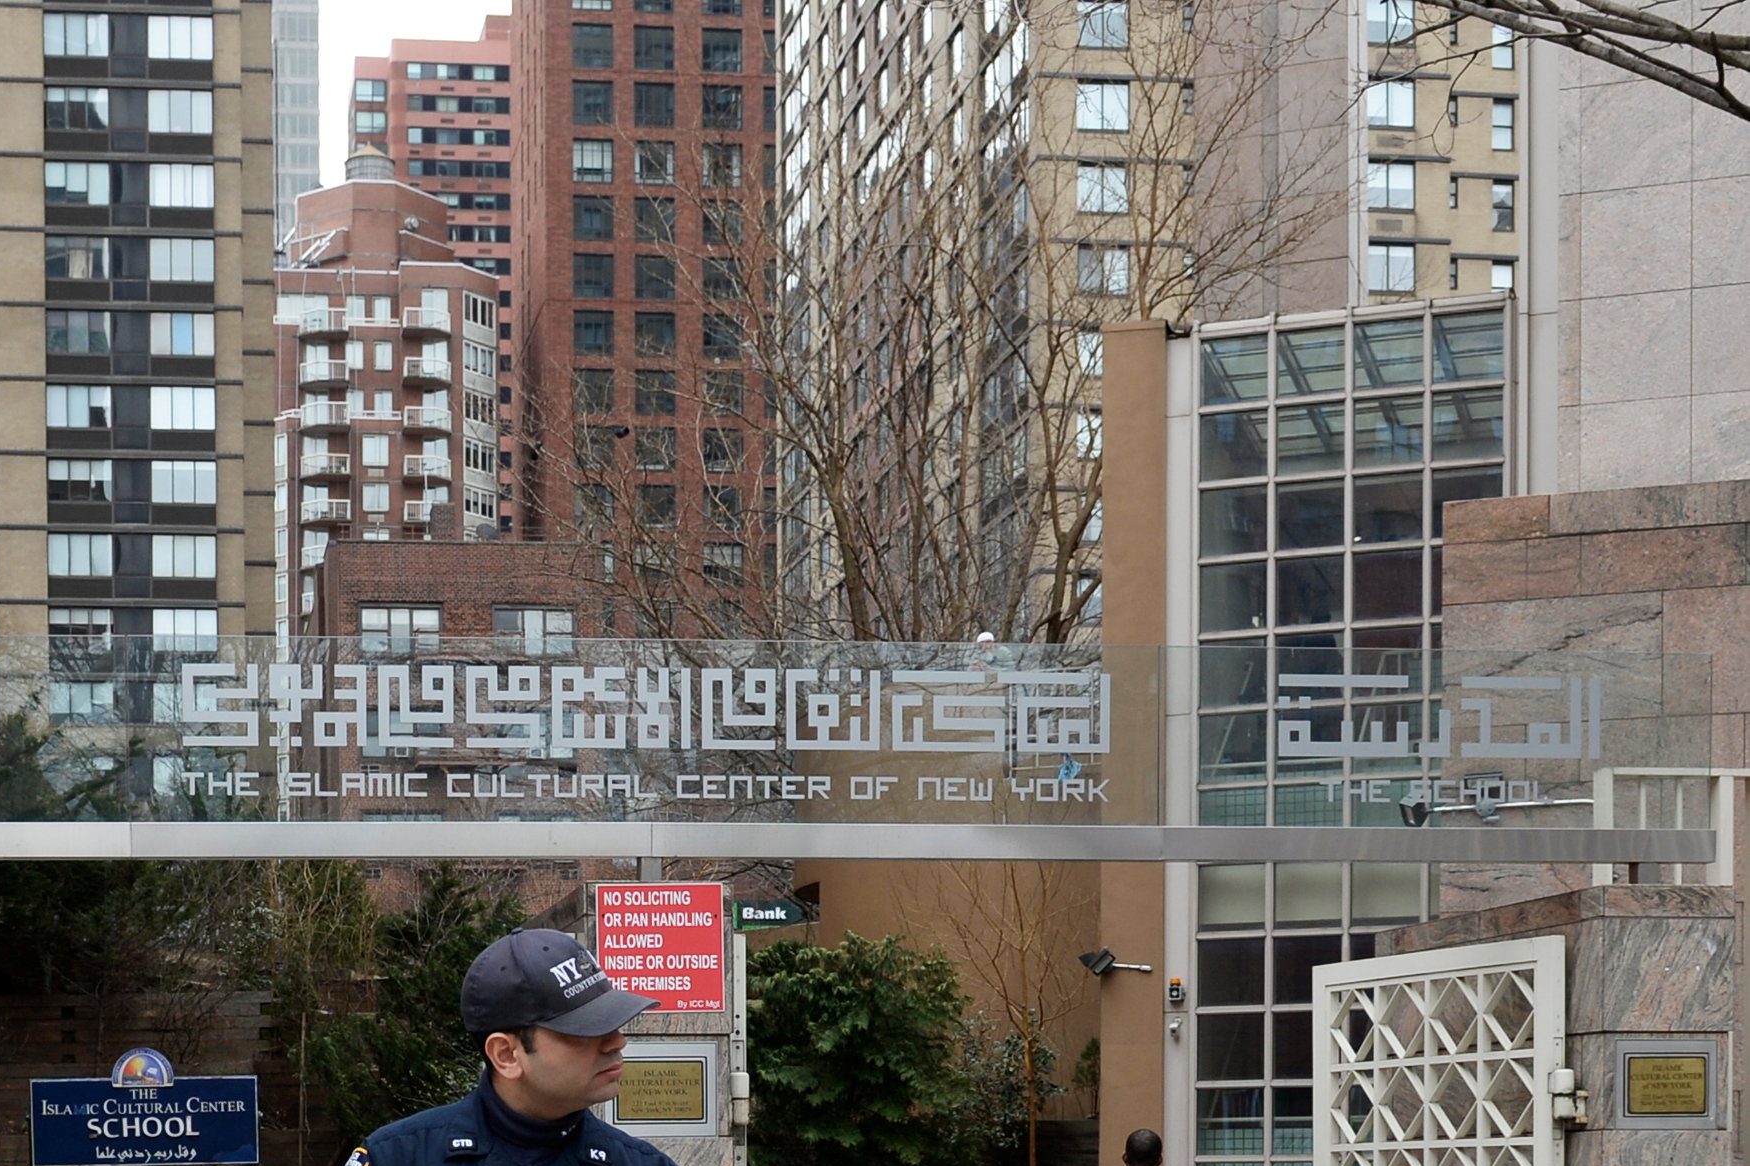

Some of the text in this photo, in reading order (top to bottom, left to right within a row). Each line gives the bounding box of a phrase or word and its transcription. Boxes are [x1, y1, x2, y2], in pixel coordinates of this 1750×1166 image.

[182, 772, 259, 796] THE
[447, 774, 658, 799] CULTURAL
[676, 775, 831, 799] CENTER
[850, 776, 898, 800] OF
[918, 776, 993, 801] NEW
[1011, 778, 1110, 802] YORK
[1319, 780, 1540, 803] THE SCHOOL
[603, 890, 691, 906] NO SOLICITING
[604, 911, 713, 927] OR PAN HANDLING
[742, 906, 787, 920] Bank
[604, 933, 663, 949] ALLOWED
[604, 954, 718, 970] INSIDE OR OUTSIDE
[606, 975, 691, 991] THE PREMISES
[677, 999, 720, 1009] By ICC Mgt
[620, 1079, 664, 1087] CULTURAL
[129, 1088, 157, 1099] THE
[103, 1099, 183, 1115] CULTURAL
[186, 1097, 245, 1113] CENTER
[87, 1116, 200, 1138] SCHOOL
[590, 1148, 607, 1161] K9
